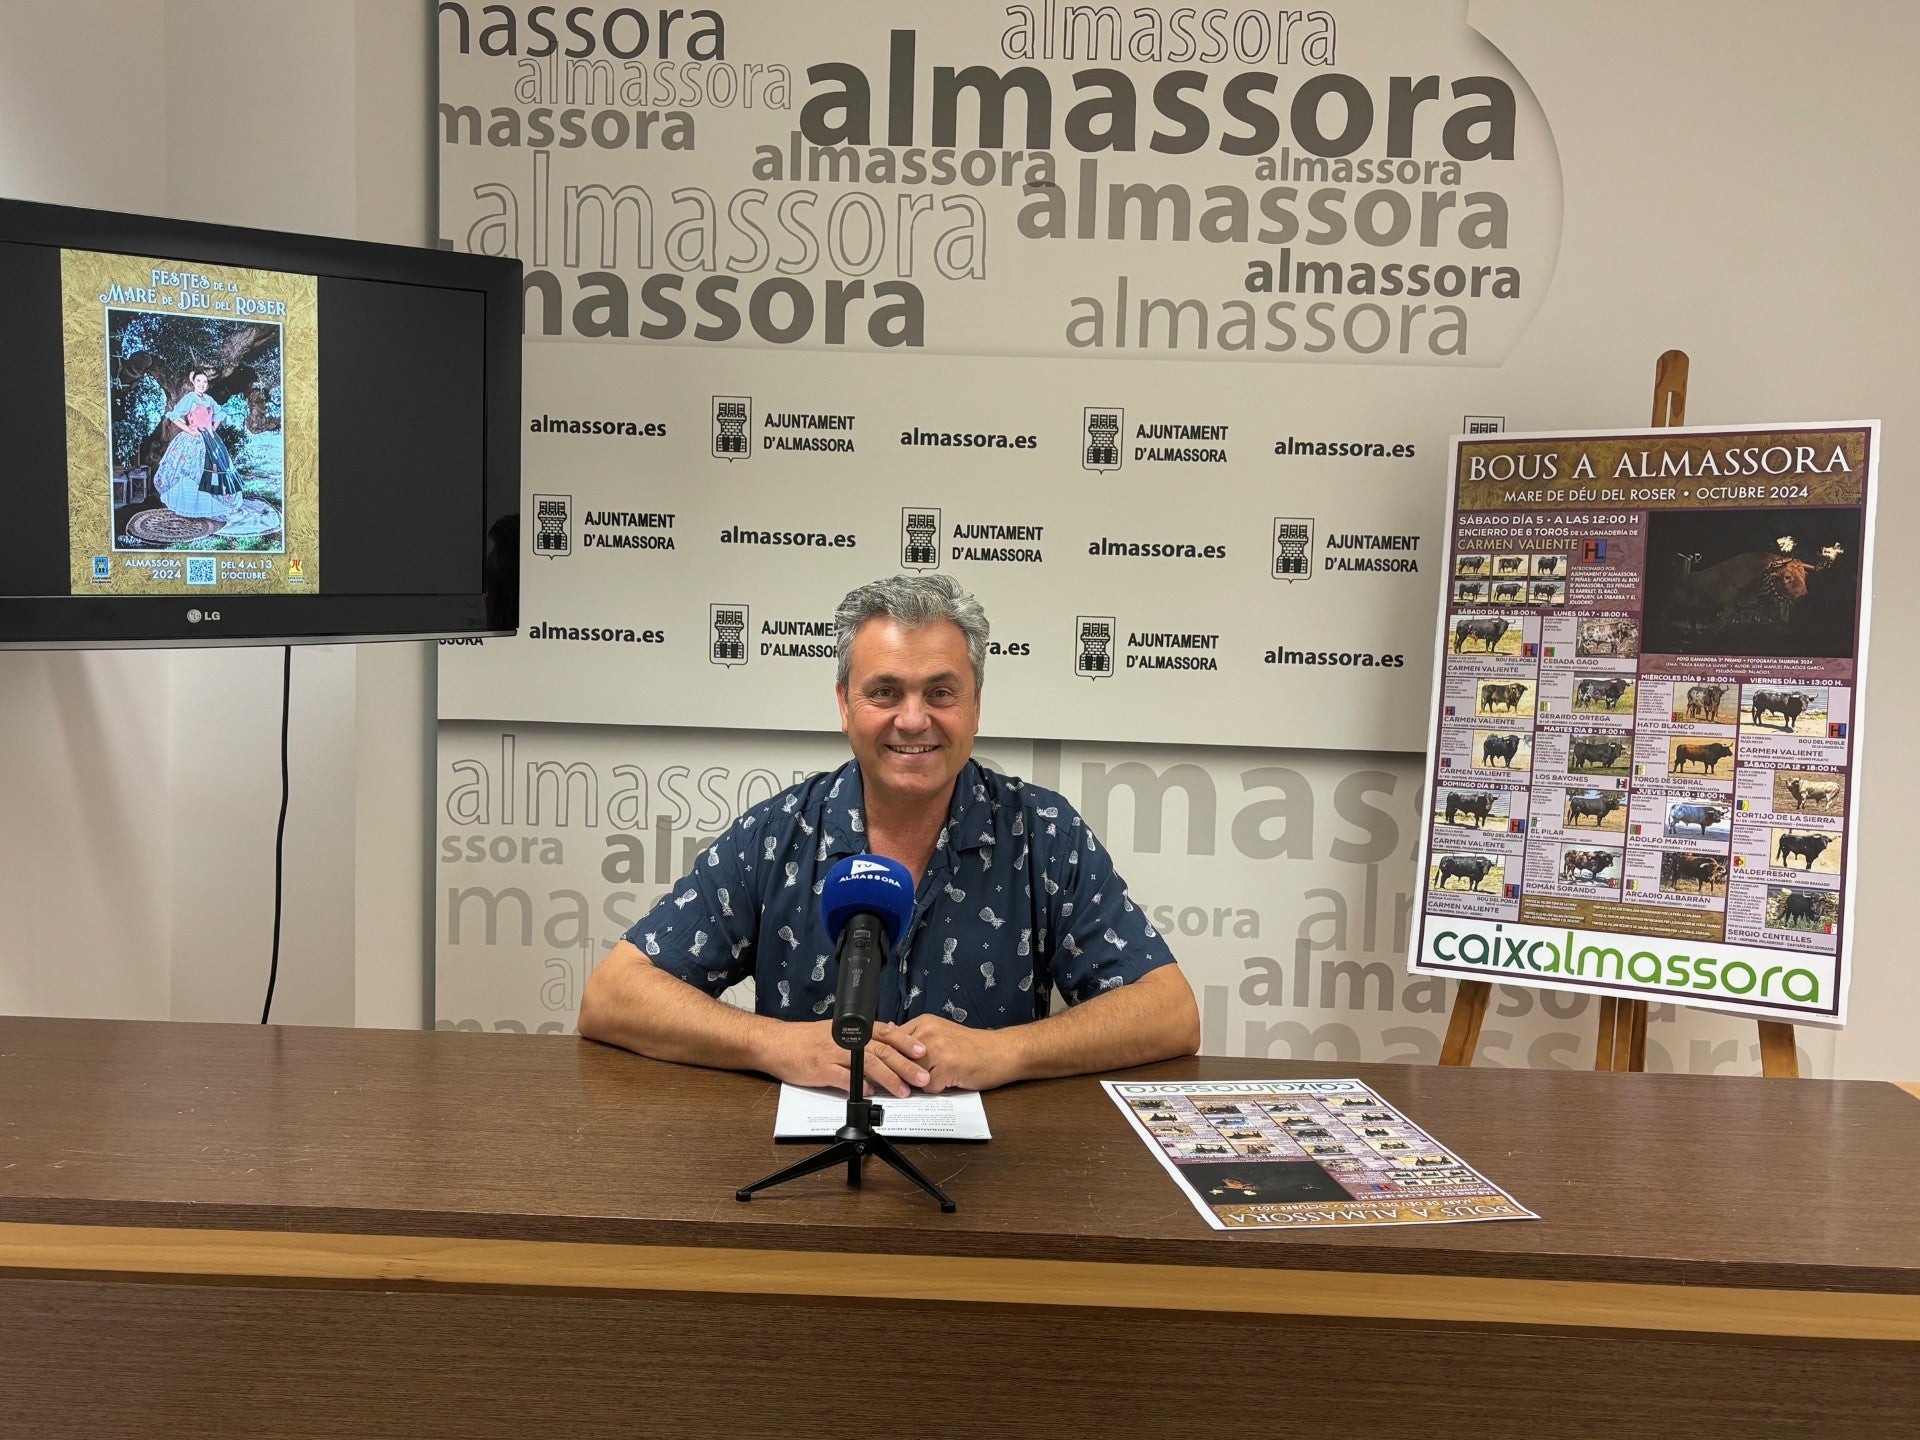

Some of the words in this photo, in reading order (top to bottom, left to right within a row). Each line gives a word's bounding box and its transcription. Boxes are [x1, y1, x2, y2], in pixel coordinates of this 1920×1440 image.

[1001, 0, 1336, 66] almassora
[514, 41, 792, 110] almassora
[800, 30, 1516, 161] almassora
[752, 131, 1056, 188] almassora
[1255, 147, 1462, 185] almassora
[1016, 158, 1509, 249] almassora
[466, 150, 986, 280] almassora
[151, 269, 210, 290] FESTES
[213, 281, 224, 291] DE
[227, 283, 238, 293] LA
[1244, 248, 1521, 298] almassora
[100, 284, 156, 305] MARE
[162, 295, 173, 306] DE
[178, 288, 210, 310] DÉU
[215, 301, 231, 311] DEL
[235, 297, 287, 317] ROSER
[1065, 276, 1468, 356] almassora
[530, 414, 667, 438] almassora.es
[764, 412, 855, 431] AJUNTAMENT
[900, 427, 1037, 451] almassora.es
[1136, 424, 1228, 441] AJUNTAMENT
[763, 435, 855, 453] D'ALMASSORA
[1274, 437, 1415, 459] almassora.es
[1135, 446, 1227, 463] D'ALMASSORA
[1468, 453, 1558, 481] BOUS
[1571, 453, 1597, 479] A
[1612, 444, 1853, 478] ALMASSORA
[1504, 490, 1542, 502] MARE
[1547, 490, 1564, 501] DE
[1569, 487, 1596, 501] DÉU
[1602, 489, 1625, 500] DEL
[1630, 488, 1676, 500] ROSER
[1696, 486, 1765, 499] OCTUBRE
[1769, 485, 1809, 499] 2024
[584, 511, 675, 529] AJUNTAMENT
[1459, 514, 1509, 525] SÁBADO
[1512, 514, 1533, 525] DÍA
[1536, 516, 1544, 524] 5
[1554, 515, 1563, 524] A
[1566, 515, 1589, 524] LAS
[1592, 515, 1626, 524] 12:00
[1630, 515, 1638, 524] H
[720, 526, 856, 549] almassora.es
[953, 524, 1044, 541] AJUNTAMENT
[1459, 528, 1508, 537] ENCIERRO
[1510, 528, 1523, 536] DE
[1525, 528, 1532, 536] 6
[1534, 528, 1569, 536] TOROS
[583, 533, 675, 550] D'ALMASSORA
[1088, 537, 1227, 560] almassora.es
[1326, 534, 1420, 551] AJUNTAMENT
[1457, 539, 1513, 550] CARMEN
[1518, 539, 1578, 550] VALIENTE
[952, 546, 1043, 563] D'ALMASSORA
[125, 559, 182, 568] ALMASSORA
[221, 561, 235, 569] DEL
[238, 560, 244, 569] 4
[260, 560, 273, 569] 13
[1325, 556, 1419, 573] D'ALMASSORA
[152, 569, 182, 579] 2024
[221, 571, 267, 580] D'OCTUBRE
[204, 611, 221, 621] LG
[529, 622, 665, 645] almassora.es
[1128, 632, 1219, 650] AJUNTAMENT
[1126, 654, 1218, 671] D'ALMASSORA
[1264, 645, 1405, 668] almassora.es
[1641, 673, 1682, 681] MIÉRCOLES
[1683, 674, 1696, 682] DÍA
[1750, 677, 1783, 685] VIERNES
[1783, 677, 1798, 685] DÍA
[1578, 714, 1611, 722] ORTEGA
[1740, 747, 1778, 755] CARMEN
[1780, 749, 1824, 757] VALIENTE
[1743, 760, 1777, 769] SÁBADO
[1442, 780, 1476, 788] DOMINGO
[1552, 775, 1589, 783] BAYONES
[1672, 778, 1703, 786] SOBRAL
[1736, 811, 1774, 820] CORTIJO
[1806, 816, 1836, 824] SIERRA
[1433, 838, 1467, 846] CARMEN
[1468, 839, 1505, 848] VALIENTE
[1629, 836, 1663, 844] ADOLFO
[1664, 838, 1697, 846] MARTÍN
[838, 874, 902, 888] ALMASSORA
[1733, 868, 1797, 879] VALDEFRESNO
[1526, 882, 1556, 891] ROMÁN
[1557, 885, 1597, 894] SORANDO
[1625, 890, 1663, 899] ARCADIO
[1664, 892, 1711, 904] ALBARRÁN
[1427, 901, 1461, 910] CARMEN
[1462, 903, 1500, 914] VALIENTE
[1728, 928, 1760, 938] SERGIO
[1762, 932, 1812, 944] CENTELLES
[1432, 924, 1820, 1003] caixalmassora
[1125, 1083, 1355, 1095] caixalmassora
[1228, 1209, 1398, 1223] ALMASSORA
[1411, 1208, 1428, 1218] A
[1440, 1205, 1514, 1217] BOUS
